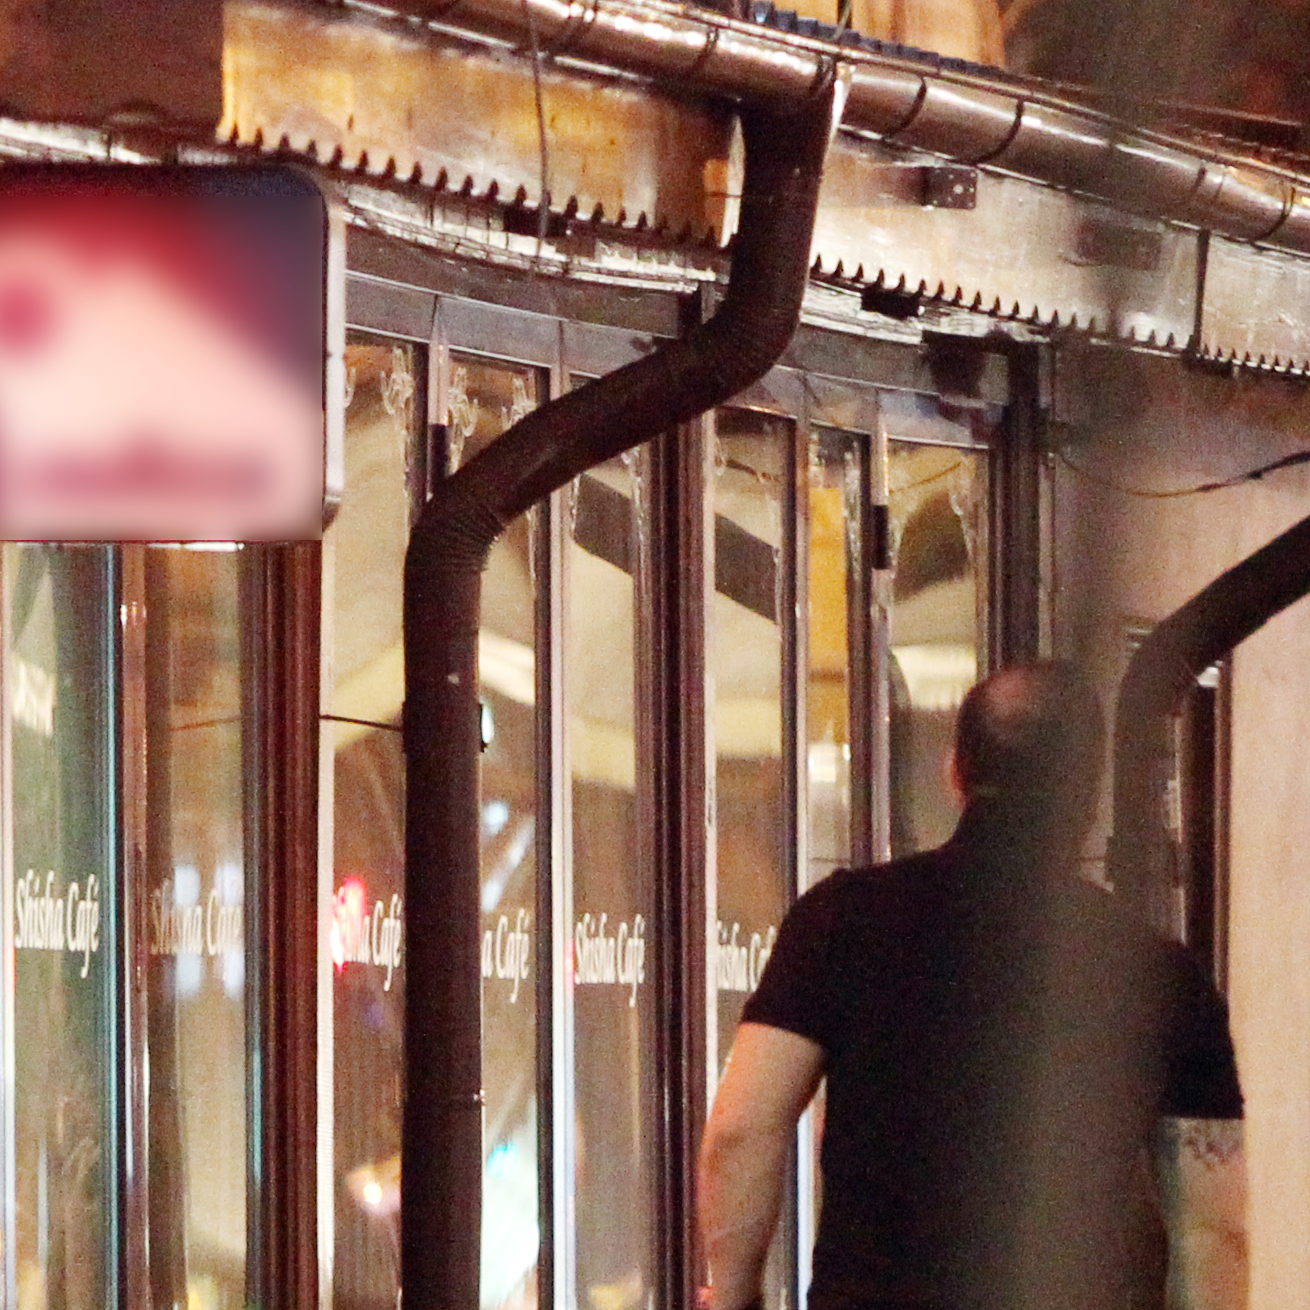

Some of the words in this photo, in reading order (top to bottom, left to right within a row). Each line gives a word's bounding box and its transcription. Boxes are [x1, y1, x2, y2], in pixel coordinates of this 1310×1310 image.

[15, 868, 64, 950] Shisha
[66, 873, 100, 978] Café
[372, 893, 403, 992] Café
[495, 907, 530, 1004] Café
[574, 912, 614, 984] Shisha
[616, 911, 645, 1008] Café
